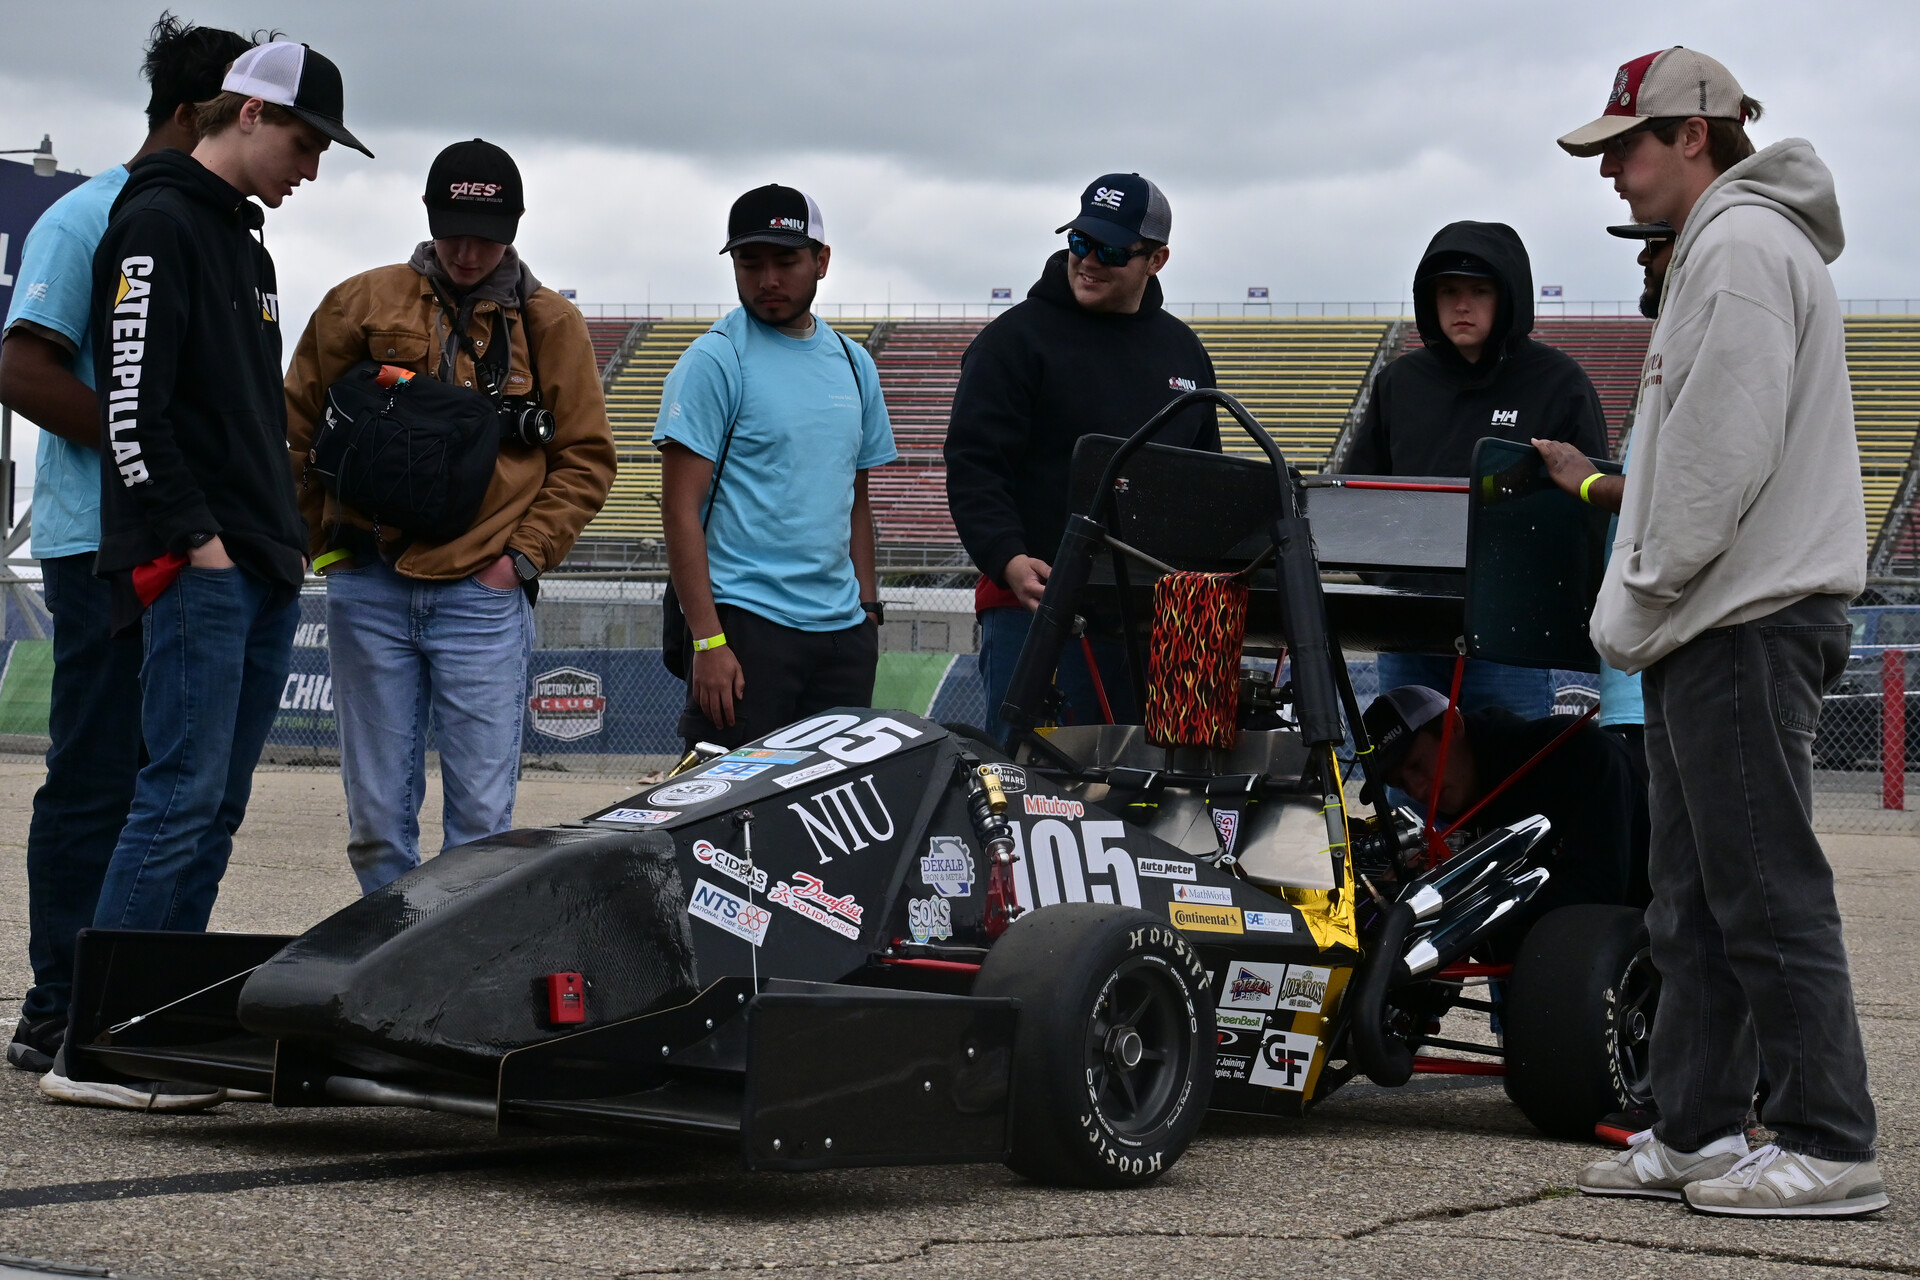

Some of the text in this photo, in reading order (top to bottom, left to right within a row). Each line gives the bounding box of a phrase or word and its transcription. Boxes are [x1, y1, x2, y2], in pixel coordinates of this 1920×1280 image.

[1093, 186, 1125, 207] SAE
[784, 217, 804, 230] NIU
[109, 256, 154, 488] CATERPILLAR
[1178, 377, 1197, 391] NIU
[1491, 409, 1518, 423] HH
[540, 683, 596, 696] VICTORY LAKE
[541, 700, 594, 709] CLUB
[706, 763, 768, 776] SAE
[1025, 796, 1083, 819] Mitutoyo
[787, 774, 894, 864] NIU
[922, 858, 964, 872] DEKALB
[1141, 861, 1193, 875] Auto Meter
[923, 873, 939, 881] IRON
[945, 873, 966, 881] METAL
[695, 885, 741, 919] NTS
[793, 873, 861, 918] Danfoss
[1189, 888, 1231, 901] MathWorks
[691, 903, 719, 920] NATIONAL
[721, 916, 737, 928] TUBE
[792, 900, 857, 938] SOLIDWORKS
[910, 898, 951, 928] SOAS
[1174, 909, 1230, 926] Continental
[1246, 912, 1292, 928] SAE CHICAGO
[1231, 978, 1273, 997] PIZZA
[1281, 978, 1327, 1006] JOE & ROSS
[1220, 1058, 1245, 1069] Joining
[1233, 1069, 1245, 1079] Inc.
[1633, 1149, 1667, 1184] N
[1763, 1163, 1817, 1199] N
